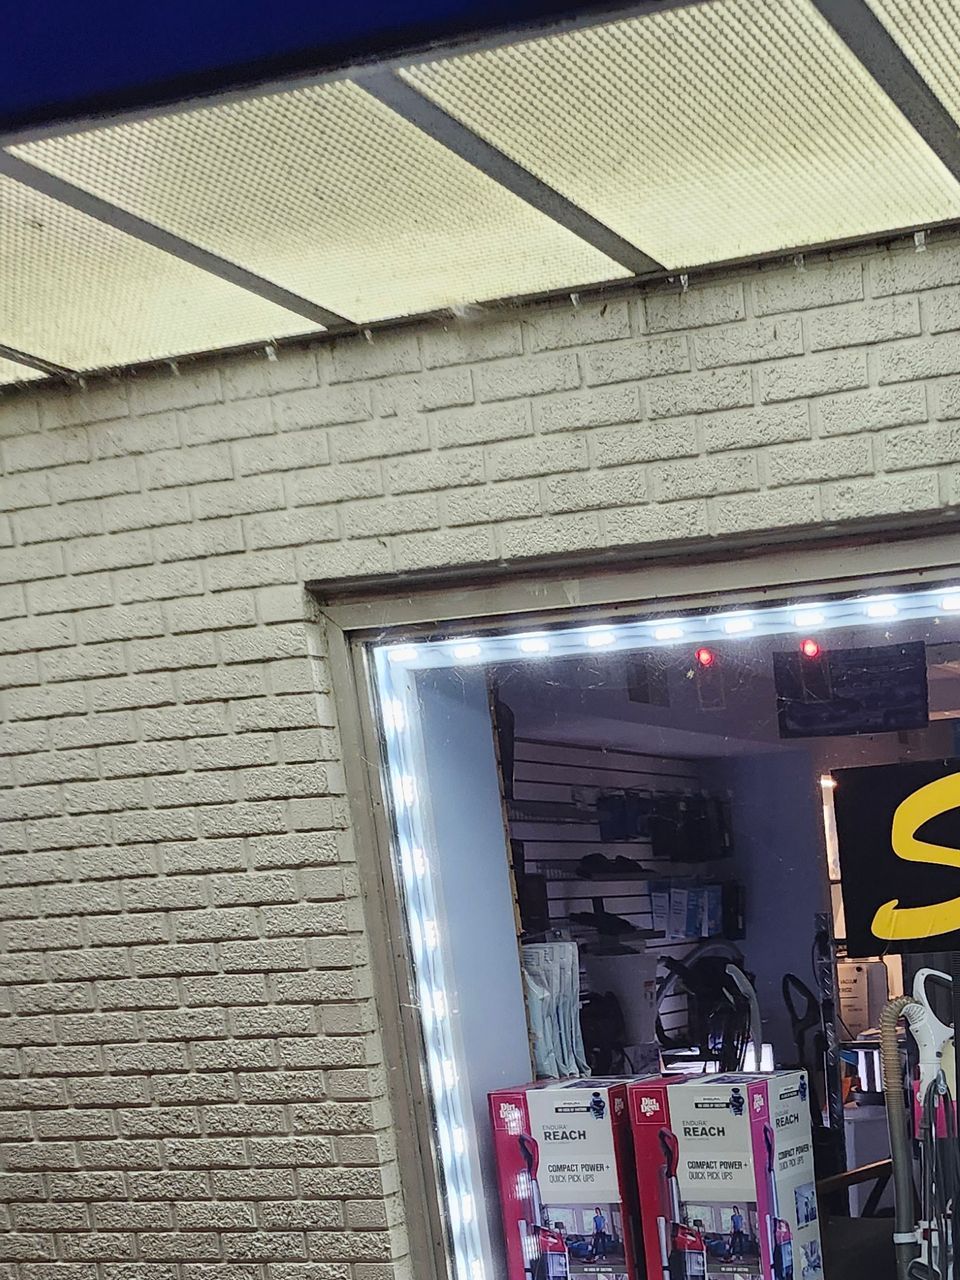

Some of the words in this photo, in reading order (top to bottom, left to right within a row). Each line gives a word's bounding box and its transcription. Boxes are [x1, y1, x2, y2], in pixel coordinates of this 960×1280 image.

[775, 1113, 799, 1129] REACH
[544, 1130, 587, 1141] REACH
[684, 1126, 725, 1137] REACH
[548, 1164, 579, 1173] COMPACT
[581, 1163, 605, 1172] POWER
[687, 1160, 718, 1170] COMPACT
[719, 1160, 743, 1170] POWER
[549, 1174, 567, 1184] QUICK
[568, 1174, 582, 1183] PICK
[583, 1173, 595, 1183] UPS
[688, 1171, 706, 1180] QUICK
[707, 1171, 720, 1180] PICK
[721, 1171, 733, 1180] UPS
